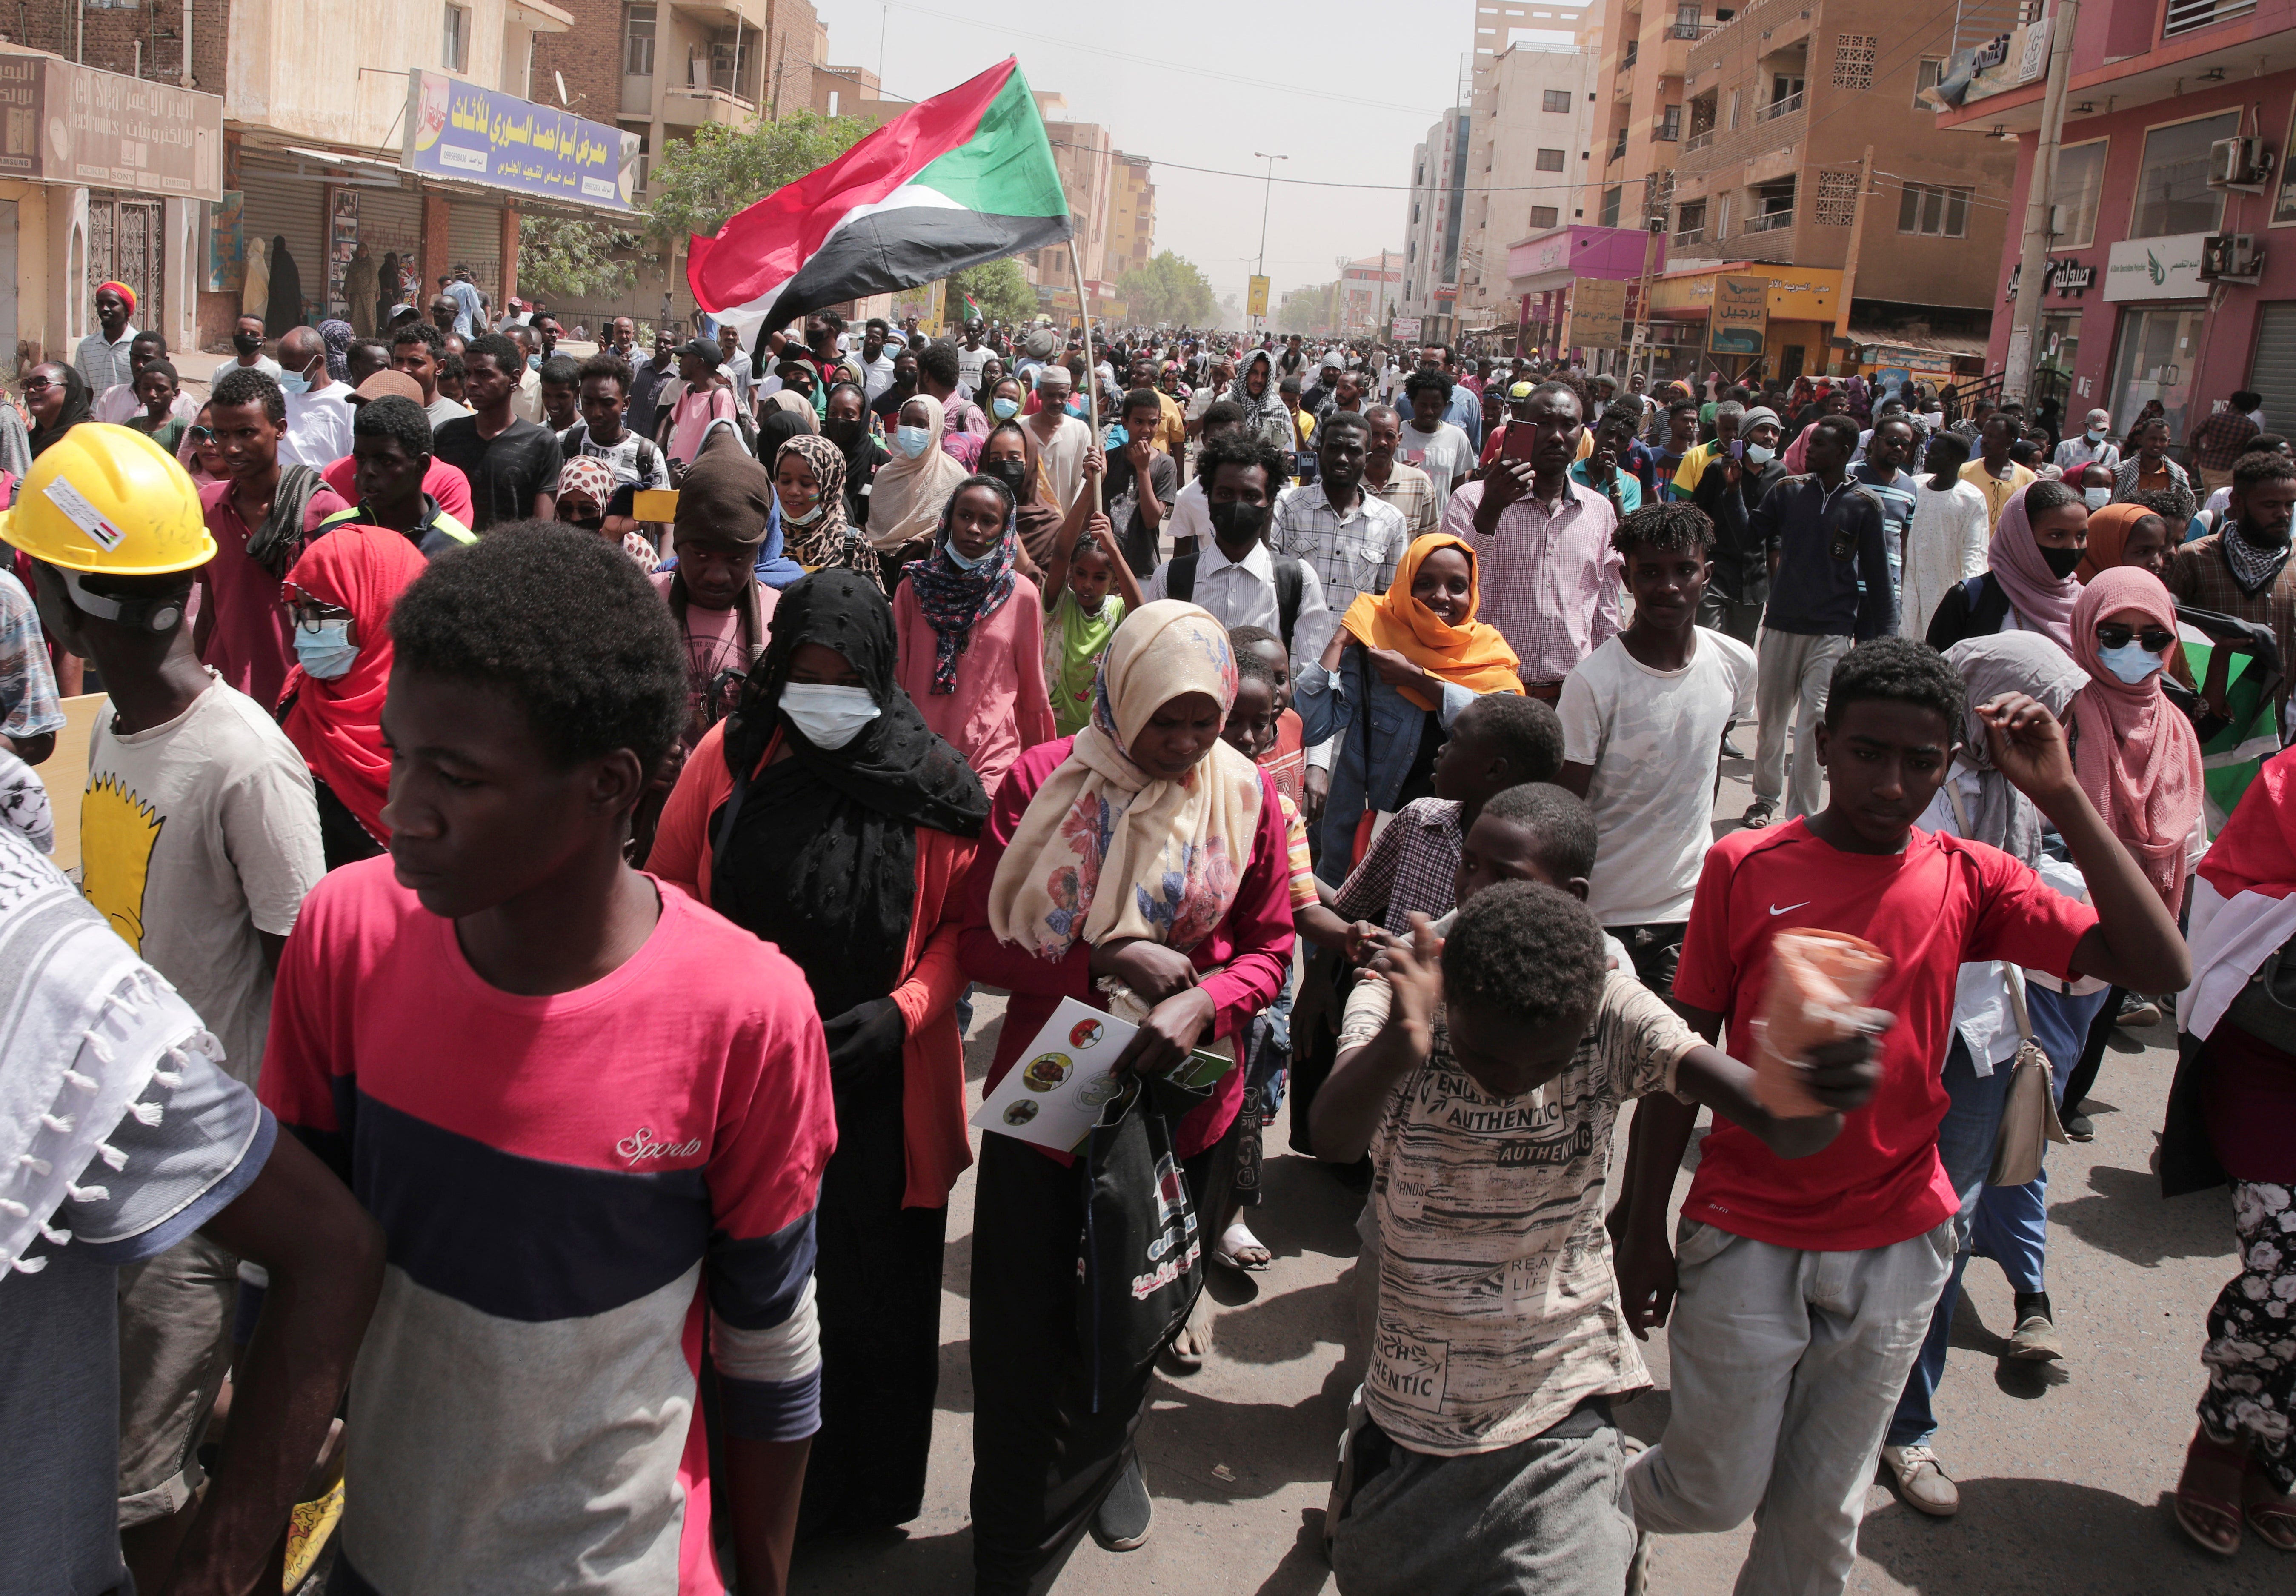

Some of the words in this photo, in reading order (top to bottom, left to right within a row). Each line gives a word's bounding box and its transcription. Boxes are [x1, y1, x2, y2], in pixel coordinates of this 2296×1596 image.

[96, 76, 119, 111] Sea
[452, 93, 489, 134] للأثاث
[490, 112, 533, 152] السوري
[533, 114, 561, 154] أحمد
[576, 130, 607, 167] معرض
[79, 166, 106, 176] NOKIA
[112, 171, 134, 182] SONY
[498, 160, 521, 177] الجلوس
[563, 172, 576, 188] قسم
[165, 178, 189, 188] SAMSUNG
[1721, 293, 1761, 303] صيدلية
[1720, 306, 1761, 320] برجيل
[1447, 1101, 1560, 1131] AUTHENTIC
[616, 1127, 701, 1167] Sports
